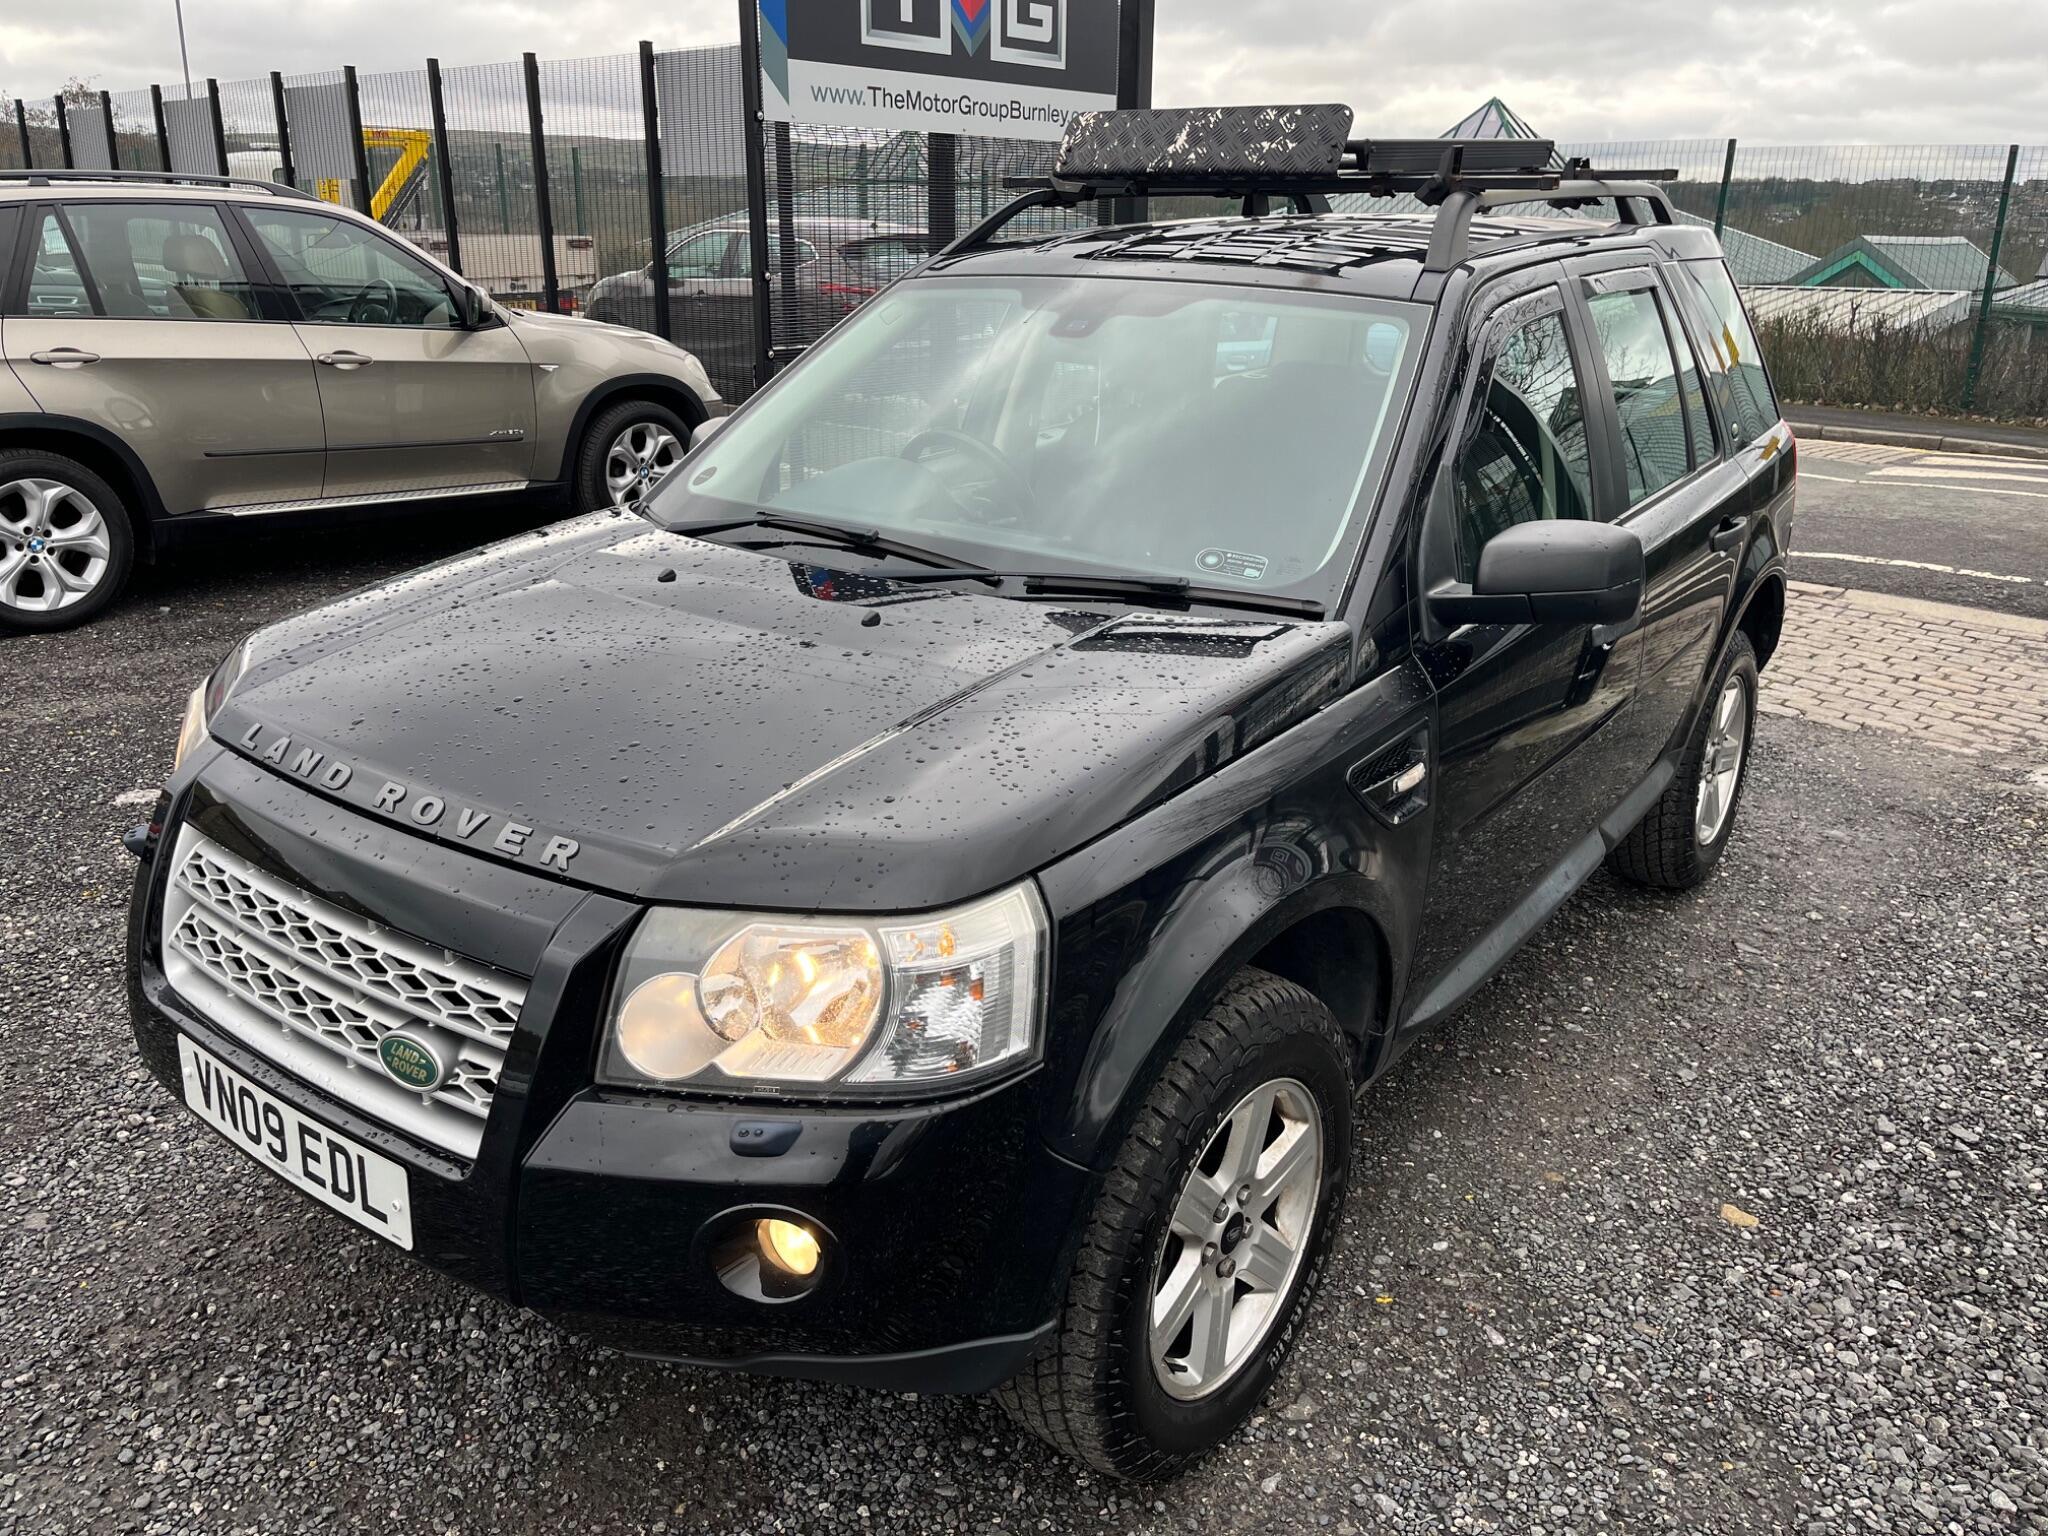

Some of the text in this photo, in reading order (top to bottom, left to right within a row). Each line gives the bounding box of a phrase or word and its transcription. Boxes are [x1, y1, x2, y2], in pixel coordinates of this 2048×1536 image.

[240, 722, 580, 872] LAND ROVER
[194, 1050, 388, 1224] VN09 EDL
[391, 1042, 428, 1082] LAND ROVER
